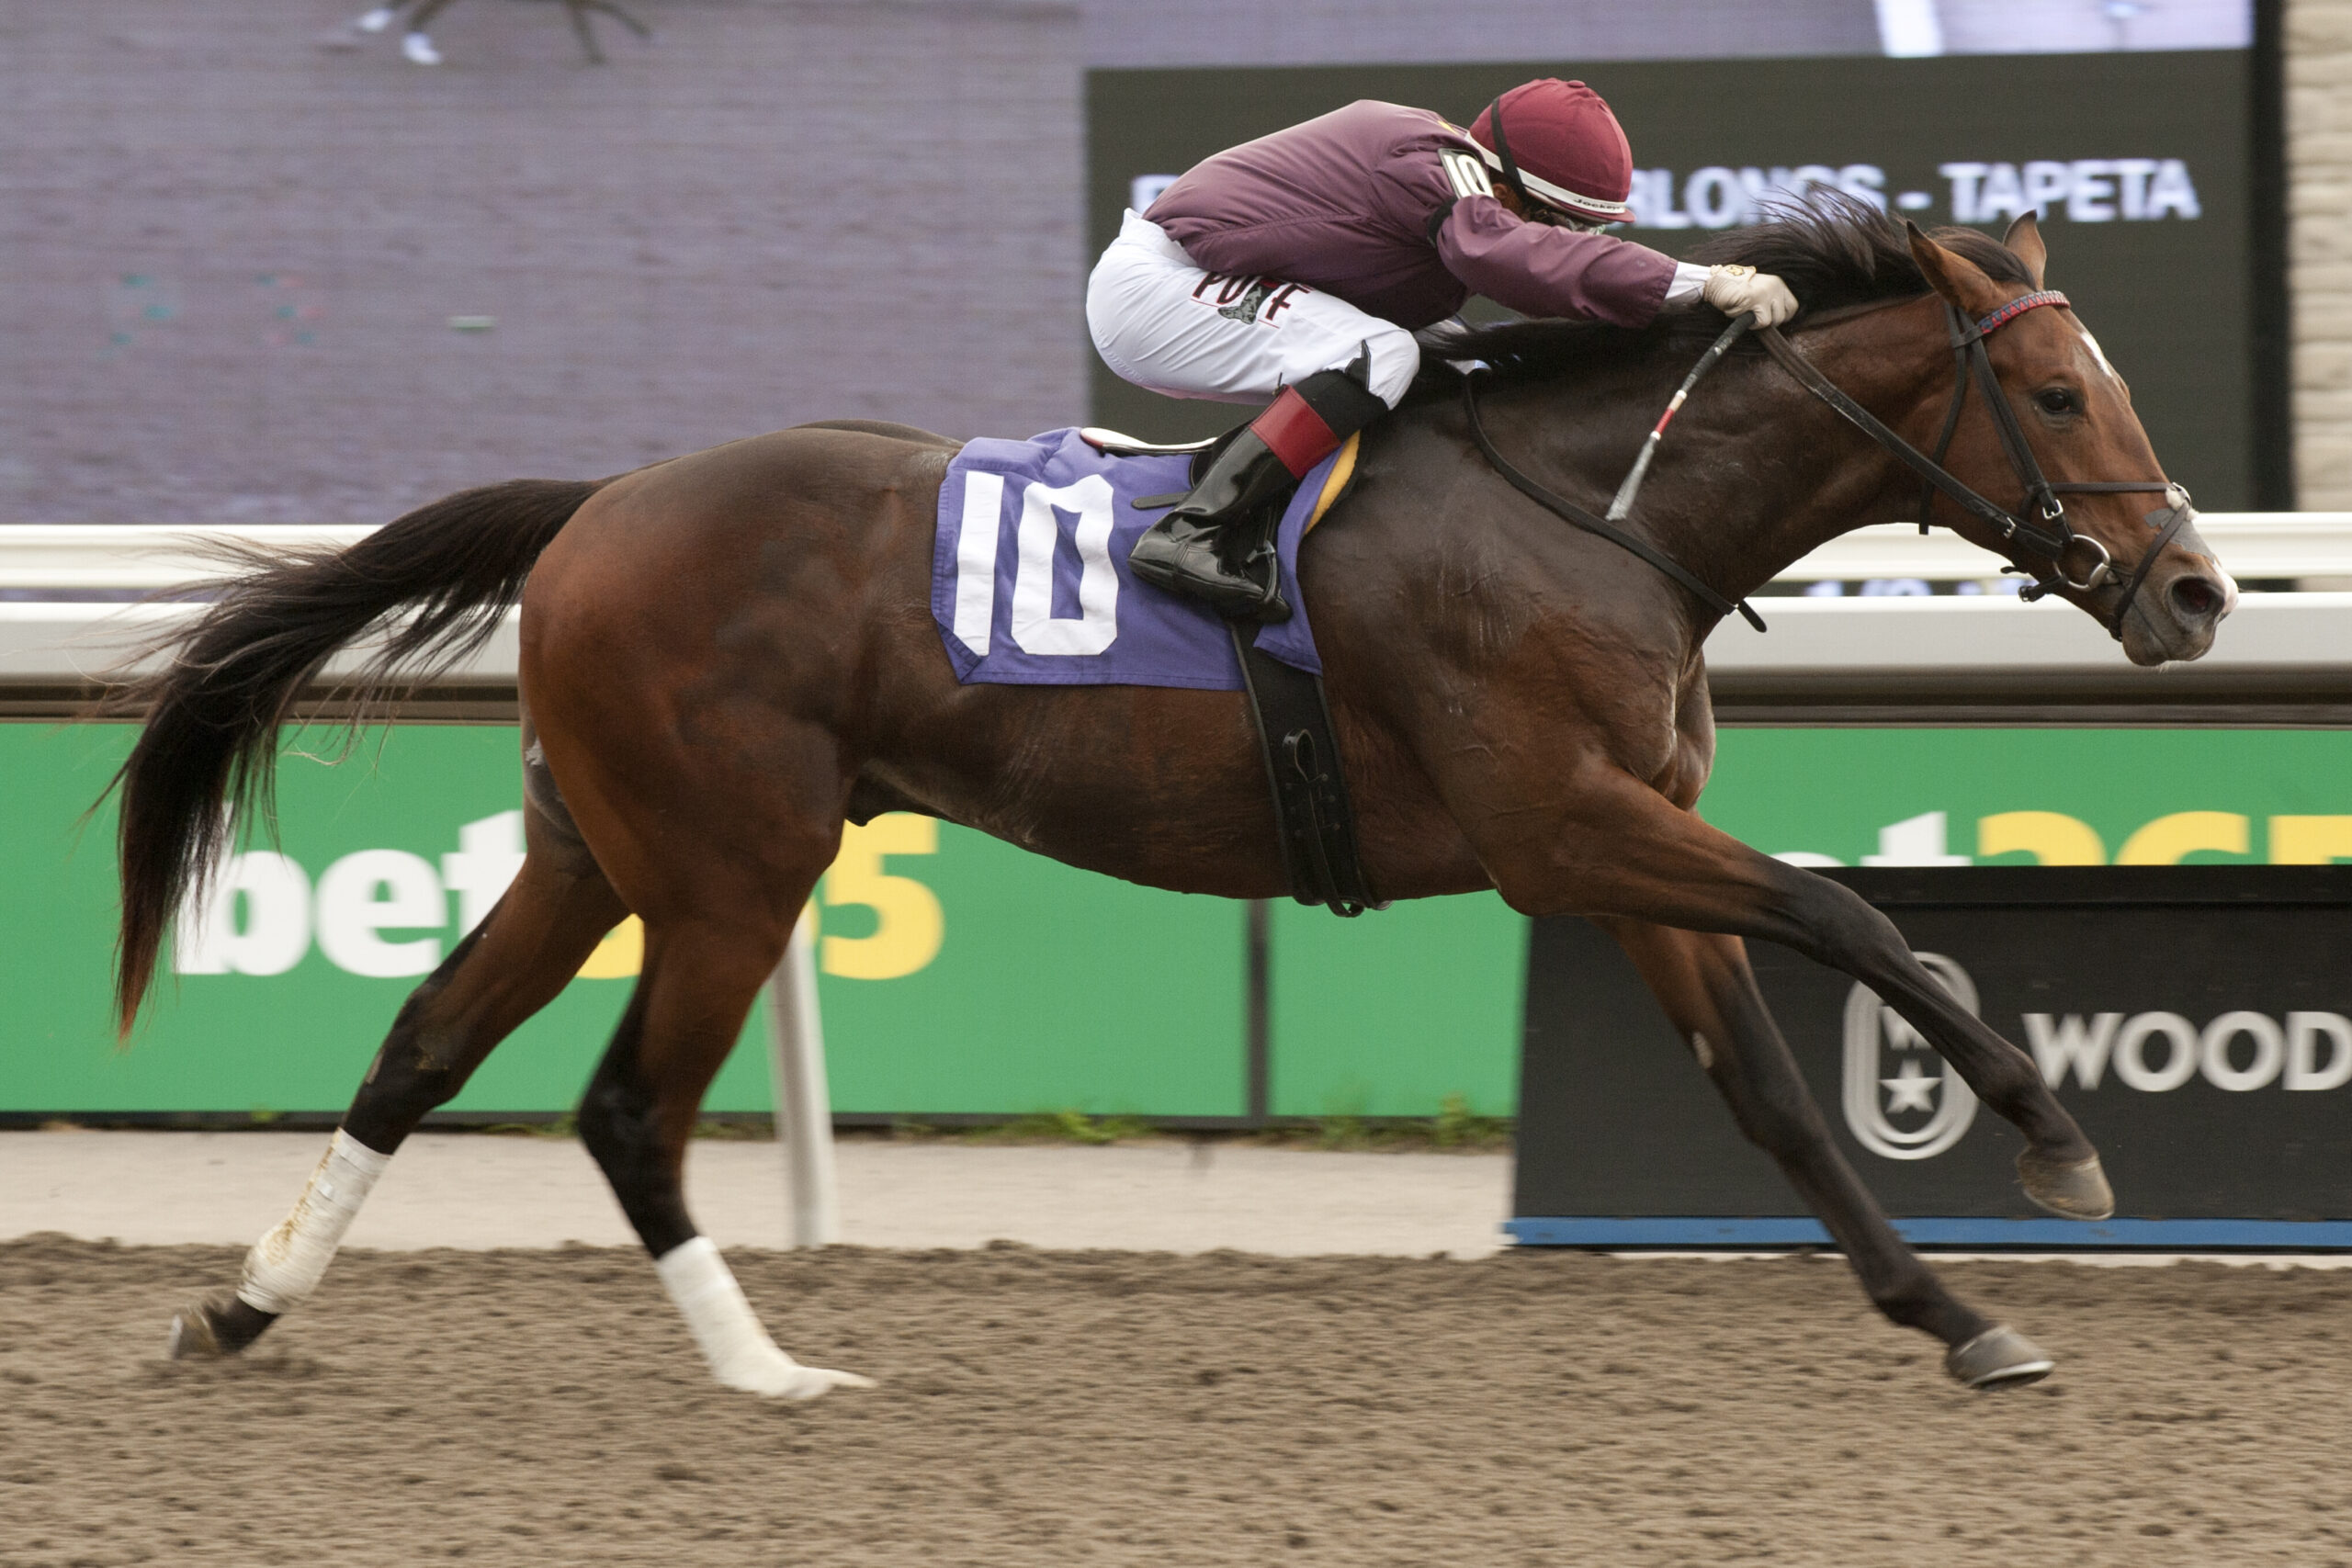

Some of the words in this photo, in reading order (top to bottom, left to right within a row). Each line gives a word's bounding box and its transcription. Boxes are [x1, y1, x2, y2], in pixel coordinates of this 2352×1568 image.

[1443, 154, 1495, 197] 10
[1939, 159, 2202, 222] TAPETA
[953, 470, 1119, 656] 10
[172, 803, 944, 979] bet5
[2022, 1010, 2352, 1092] WOOD
